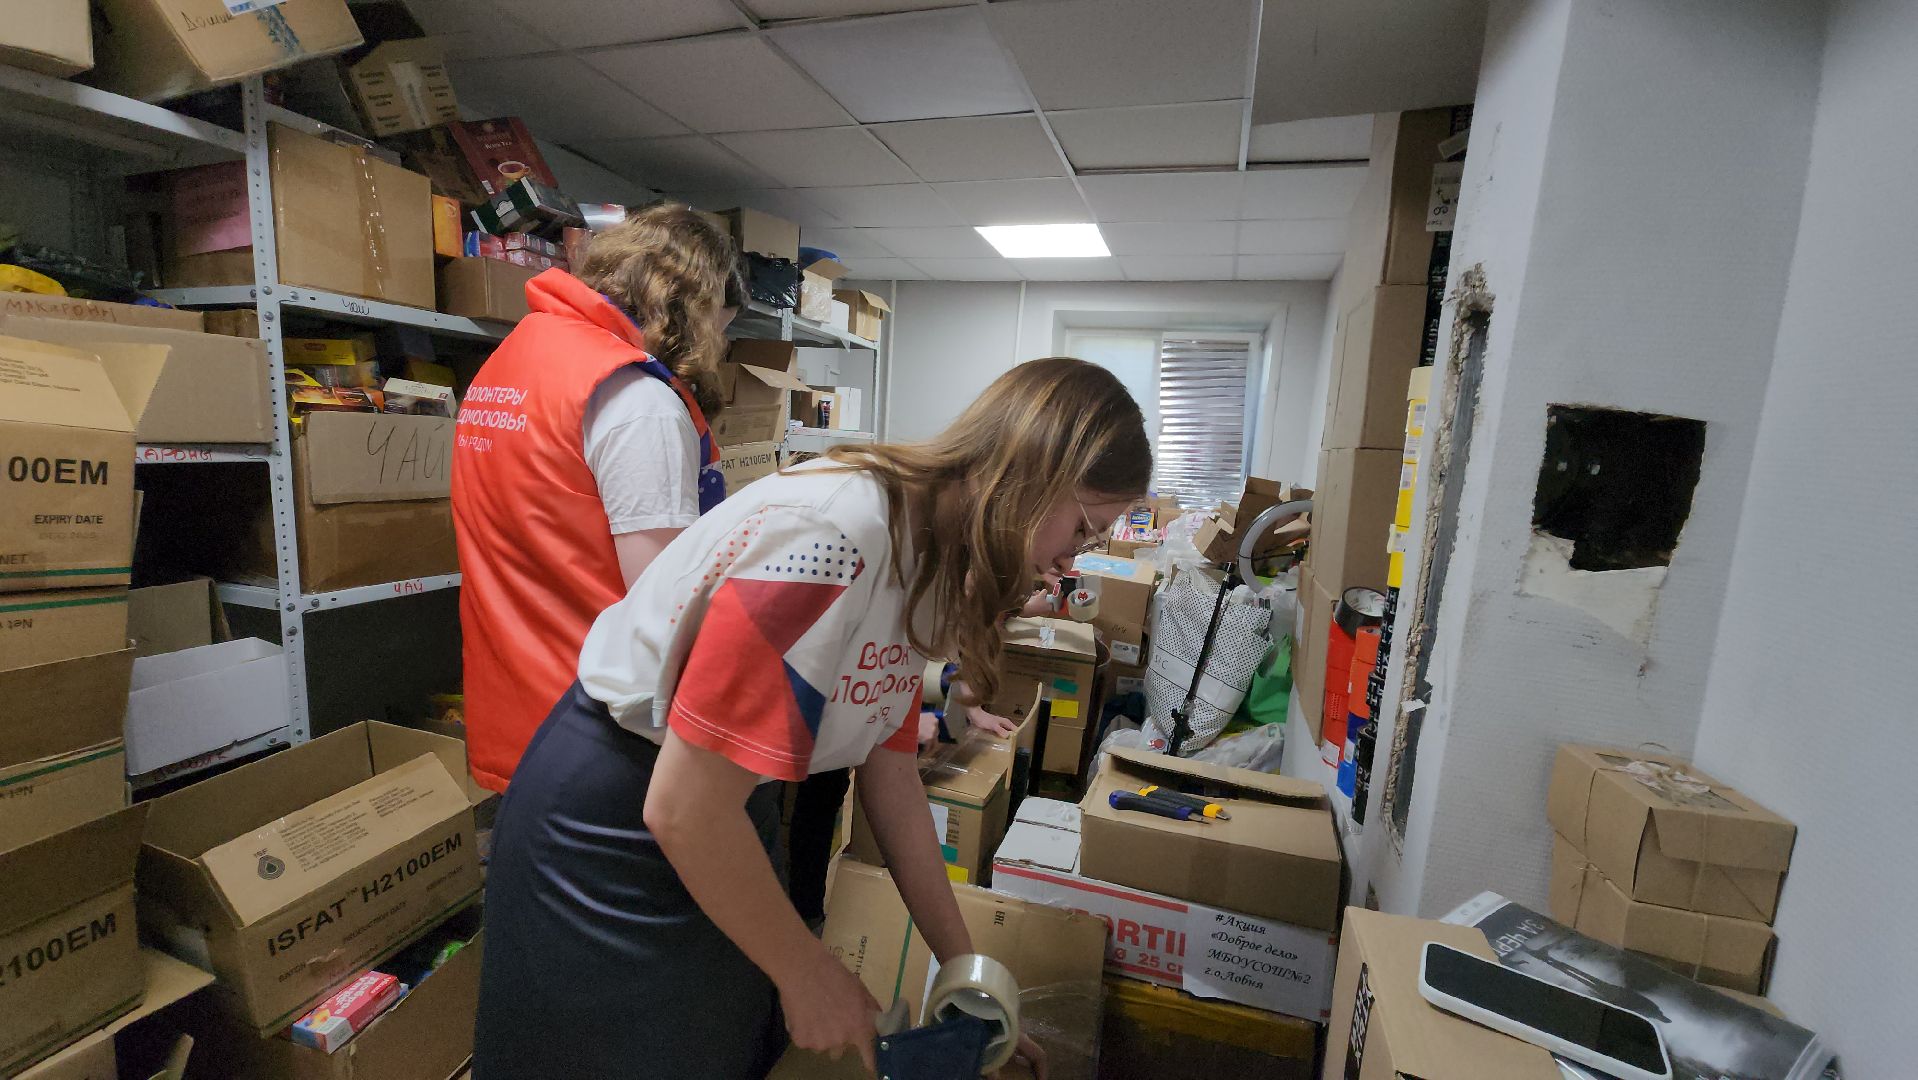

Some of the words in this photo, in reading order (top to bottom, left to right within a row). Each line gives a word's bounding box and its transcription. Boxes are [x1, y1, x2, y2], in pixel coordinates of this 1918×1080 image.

[456, 407, 528, 432] ДМОСКОВЬЯ
[367, 421, 446, 484] ЧАЙ
[0, 456, 109, 486] 00EM
[34, 514, 73, 525] EXPIRY
[75, 514, 104, 525] DATE
[361, 832, 463, 902] H2100EM
[0, 912, 117, 987] 100EM
[1137, 952, 1160, 968] 25
